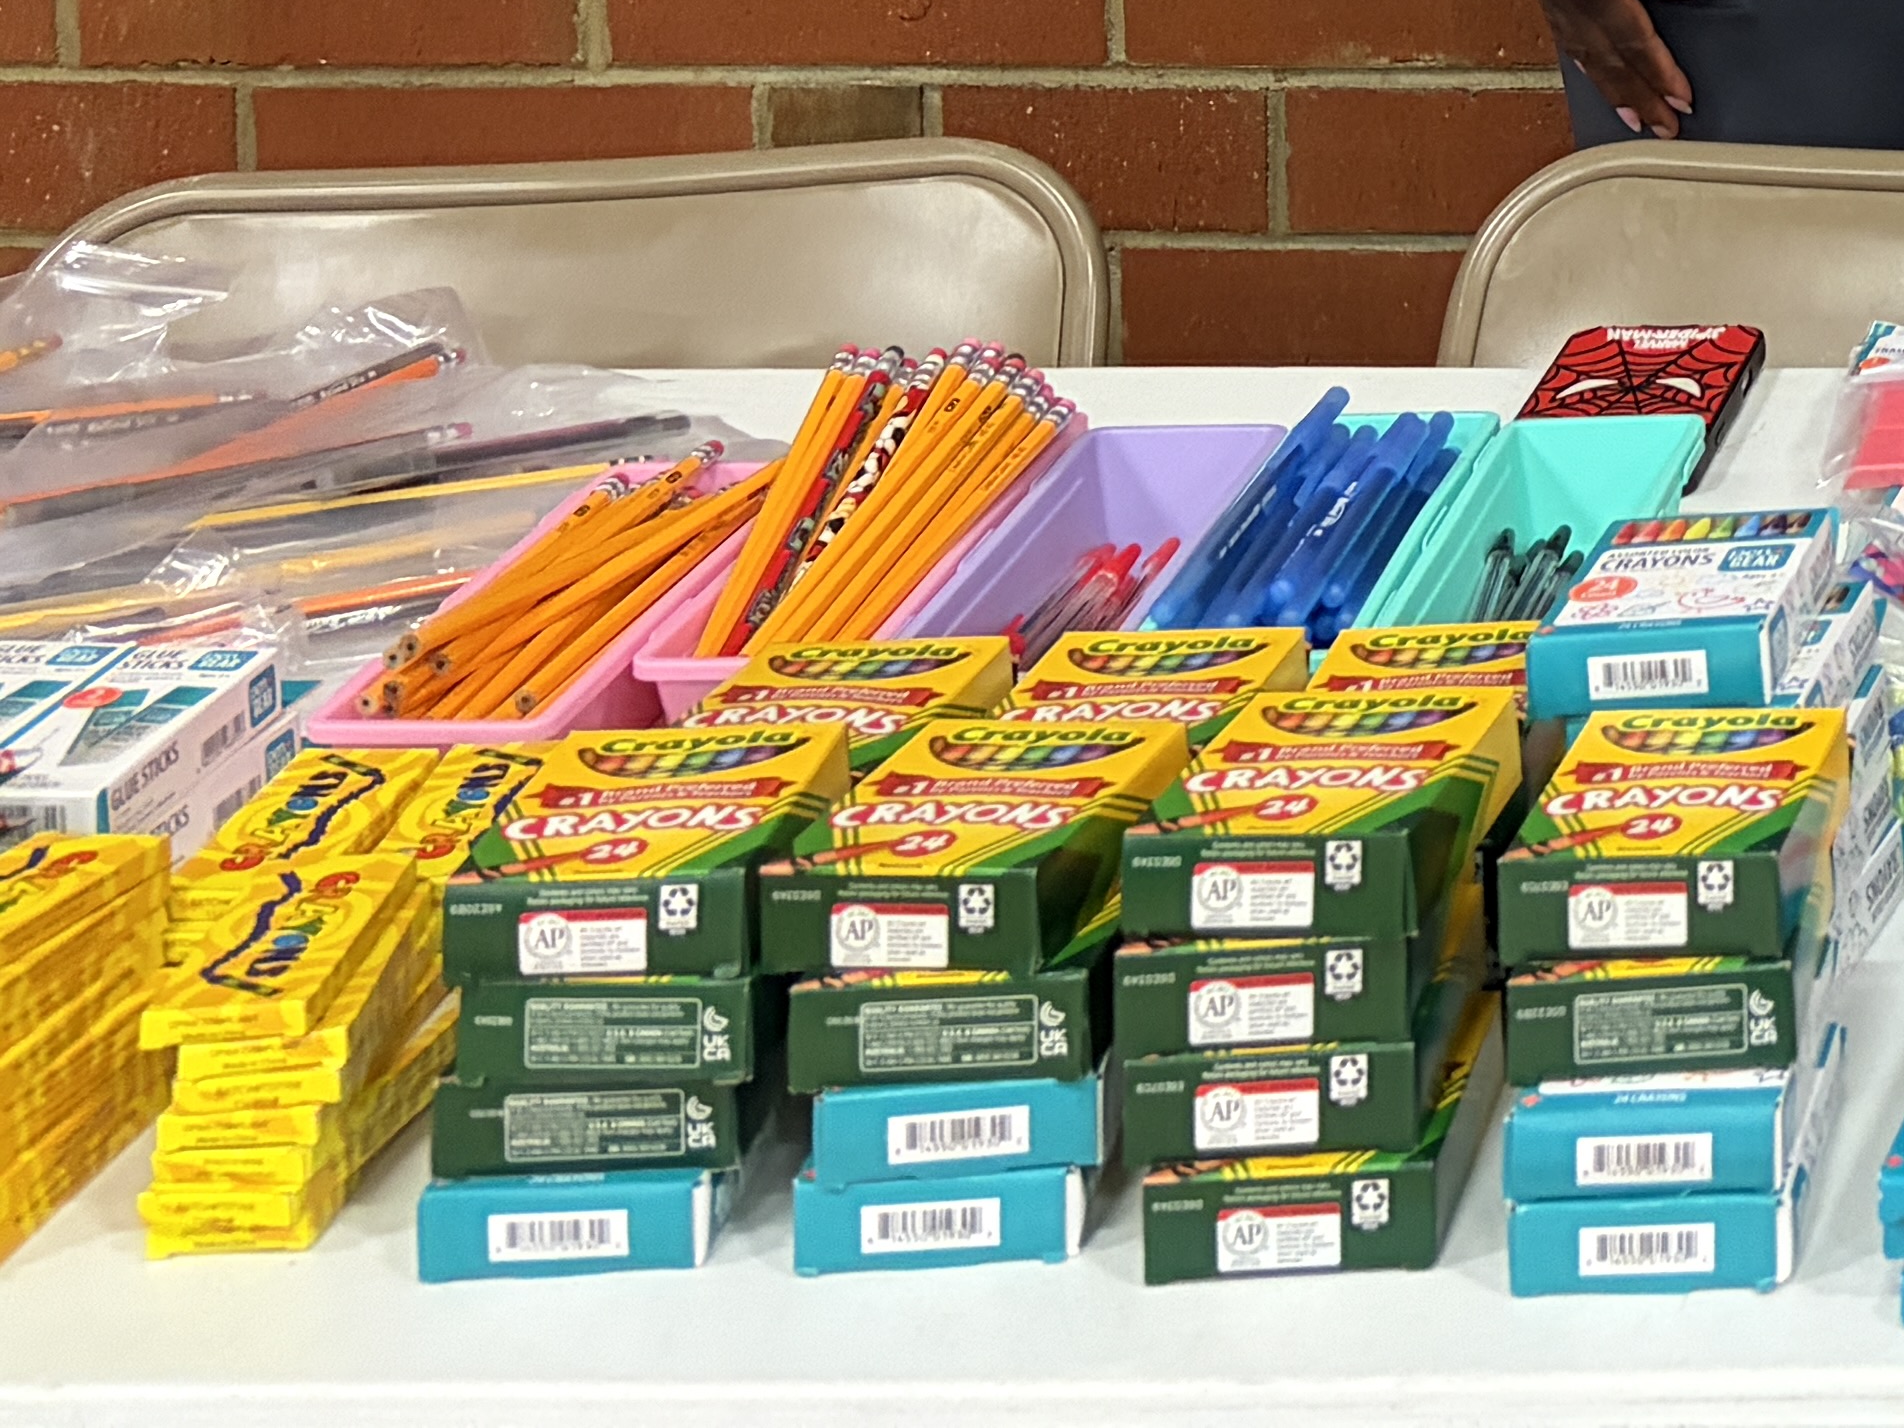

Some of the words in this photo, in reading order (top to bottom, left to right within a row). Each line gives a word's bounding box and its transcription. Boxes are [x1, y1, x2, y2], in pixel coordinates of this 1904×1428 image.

[1600, 553, 1716, 572] CRAYONS
[1728, 554, 1780, 568] GEAR
[1592, 578, 1619, 590] 24
[1088, 635, 1256, 656] Crayola
[1370, 627, 1534, 648] Crayola
[787, 642, 964, 661] Crayola
[115, 659, 185, 671] STICKS
[1002, 699, 1225, 724] CRAYONS
[1282, 693, 1465, 712] Crayola
[685, 706, 906, 735] CRAYONS
[1622, 711, 1798, 731] Crayola
[600, 729, 796, 754] Crayola
[950, 724, 1134, 744] Crayola
[111, 776, 140, 812] GLUE
[141, 740, 181, 786] STICKS
[1184, 766, 1428, 795] CRAYONS
[1256, 797, 1311, 818] 24
[1543, 783, 1784, 816] CRAYONS
[504, 805, 766, 841] CRAYONS
[832, 800, 1080, 830] CRAYONS
[1625, 815, 1677, 836] 24
[584, 842, 640, 860] 24
[894, 833, 951, 853] 24
[1207, 880, 1238, 902] AP
[1580, 896, 1613, 922] AP
[534, 928, 566, 949] AP
[847, 920, 873, 942] AP
[1204, 1000, 1235, 1017] AP
[703, 1035, 730, 1049] UK
[1040, 1029, 1067, 1043] UK
[1210, 1101, 1241, 1121] AP
[1233, 1224, 1262, 1244] AP
